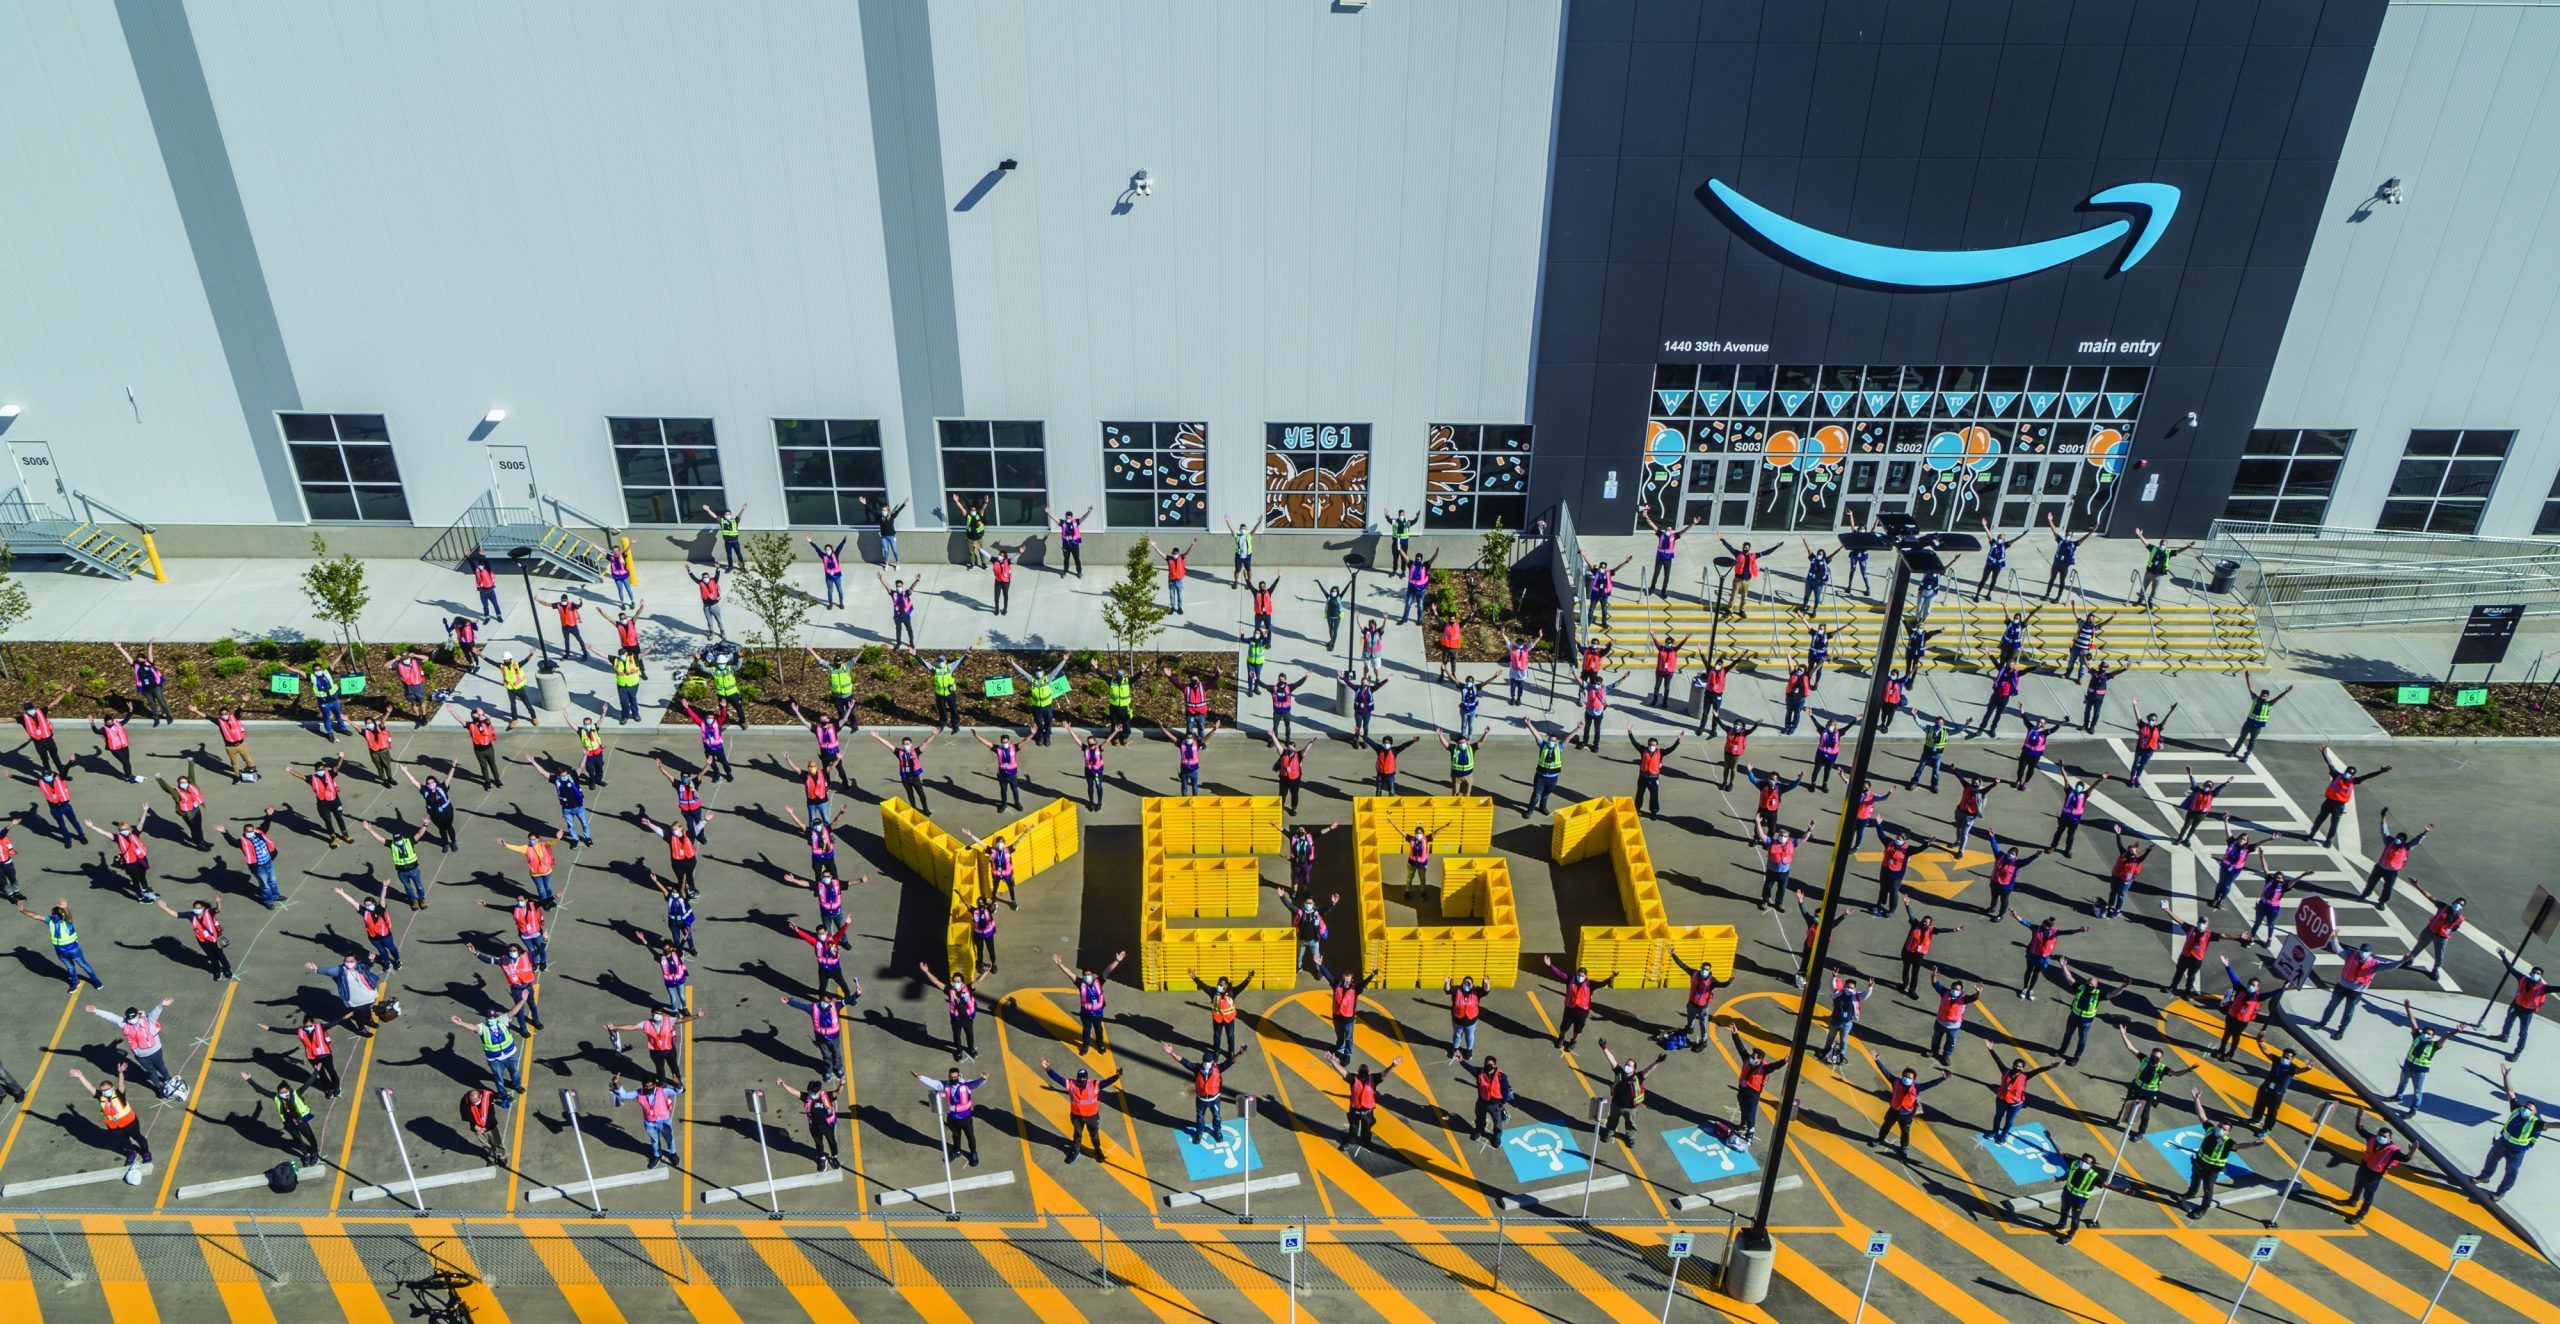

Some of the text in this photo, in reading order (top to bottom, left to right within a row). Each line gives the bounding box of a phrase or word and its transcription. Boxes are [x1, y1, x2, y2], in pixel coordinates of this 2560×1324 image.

[1664, 341, 1769, 352] 1440 39th Avenue
[2078, 338, 2161, 357] main entry
[1664, 393, 2125, 410] WELCOME TO DAY 1
[1283, 426, 1352, 449] YEG1
[1734, 442, 1761, 452] S003
[1895, 443, 1923, 453] S002
[2058, 444, 2085, 454] S001
[22, 456, 49, 466] S006
[499, 460, 526, 470] S005
[2299, 905, 2329, 938] STOP
